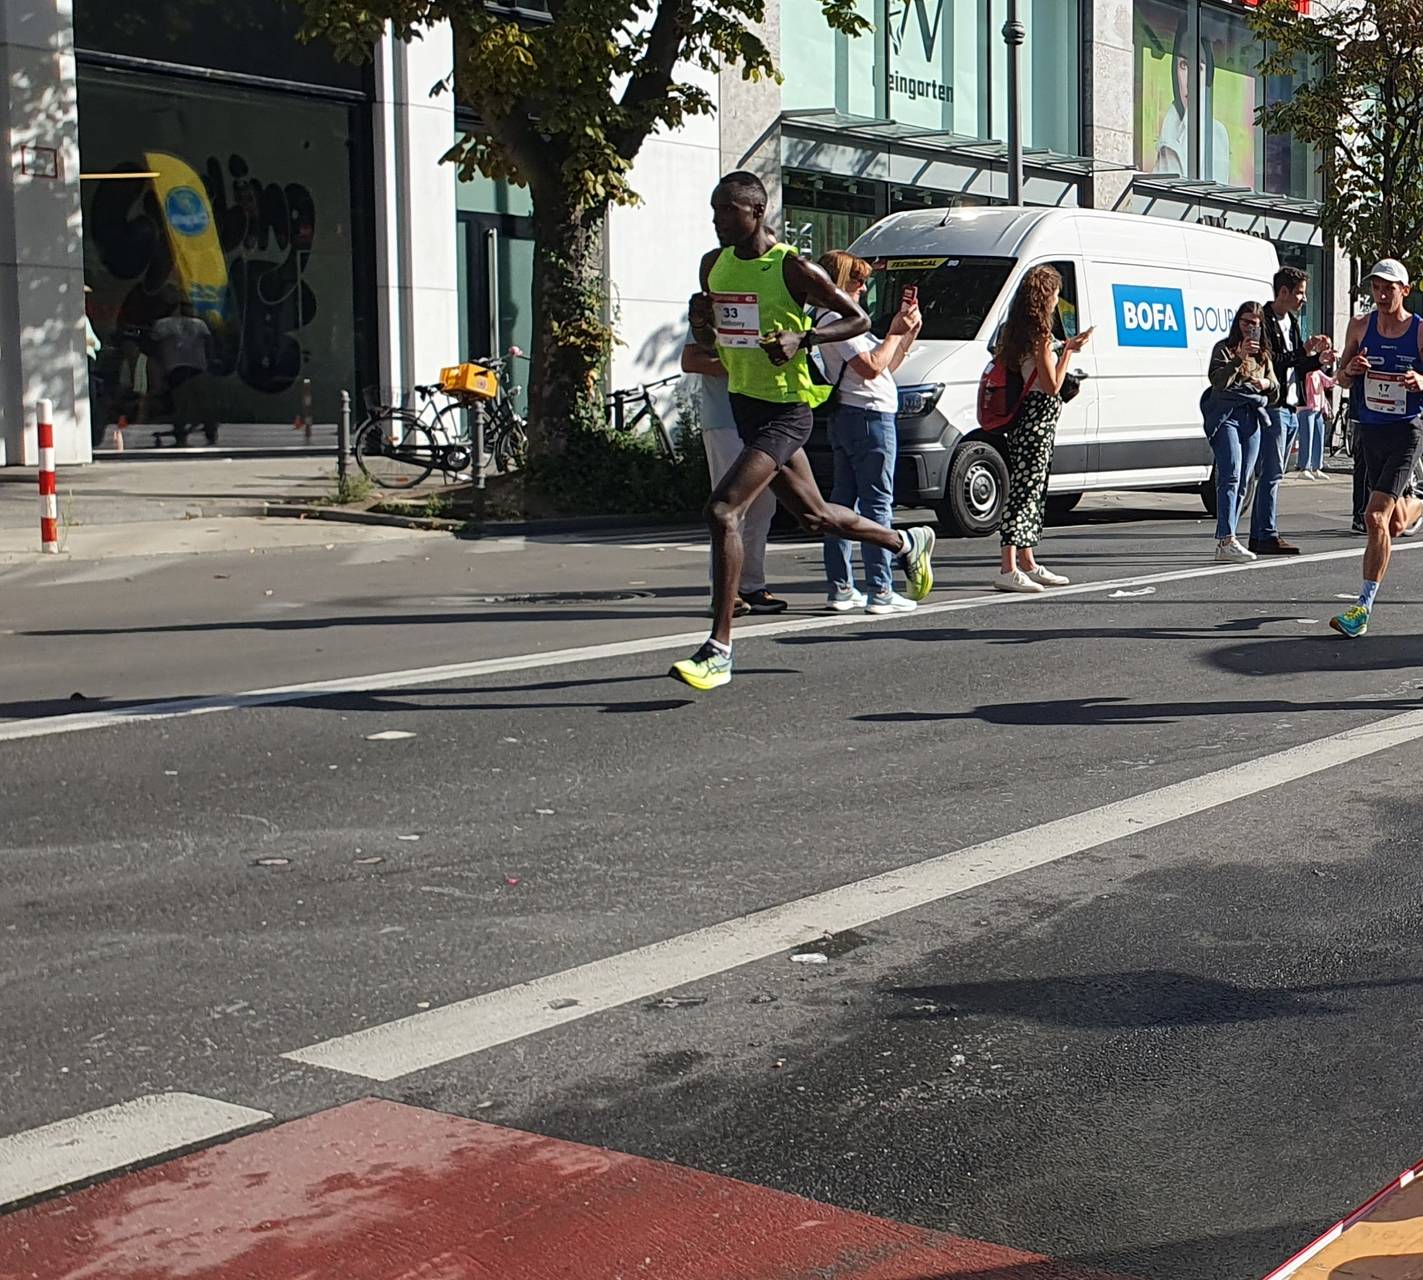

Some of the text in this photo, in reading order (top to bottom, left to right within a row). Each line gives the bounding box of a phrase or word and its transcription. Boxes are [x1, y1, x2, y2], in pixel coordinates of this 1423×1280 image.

[873, 70, 953, 103] eingarten
[723, 307, 738, 318] 33
[1123, 301, 1178, 331] BOFA
[1378, 384, 1390, 392] 17
